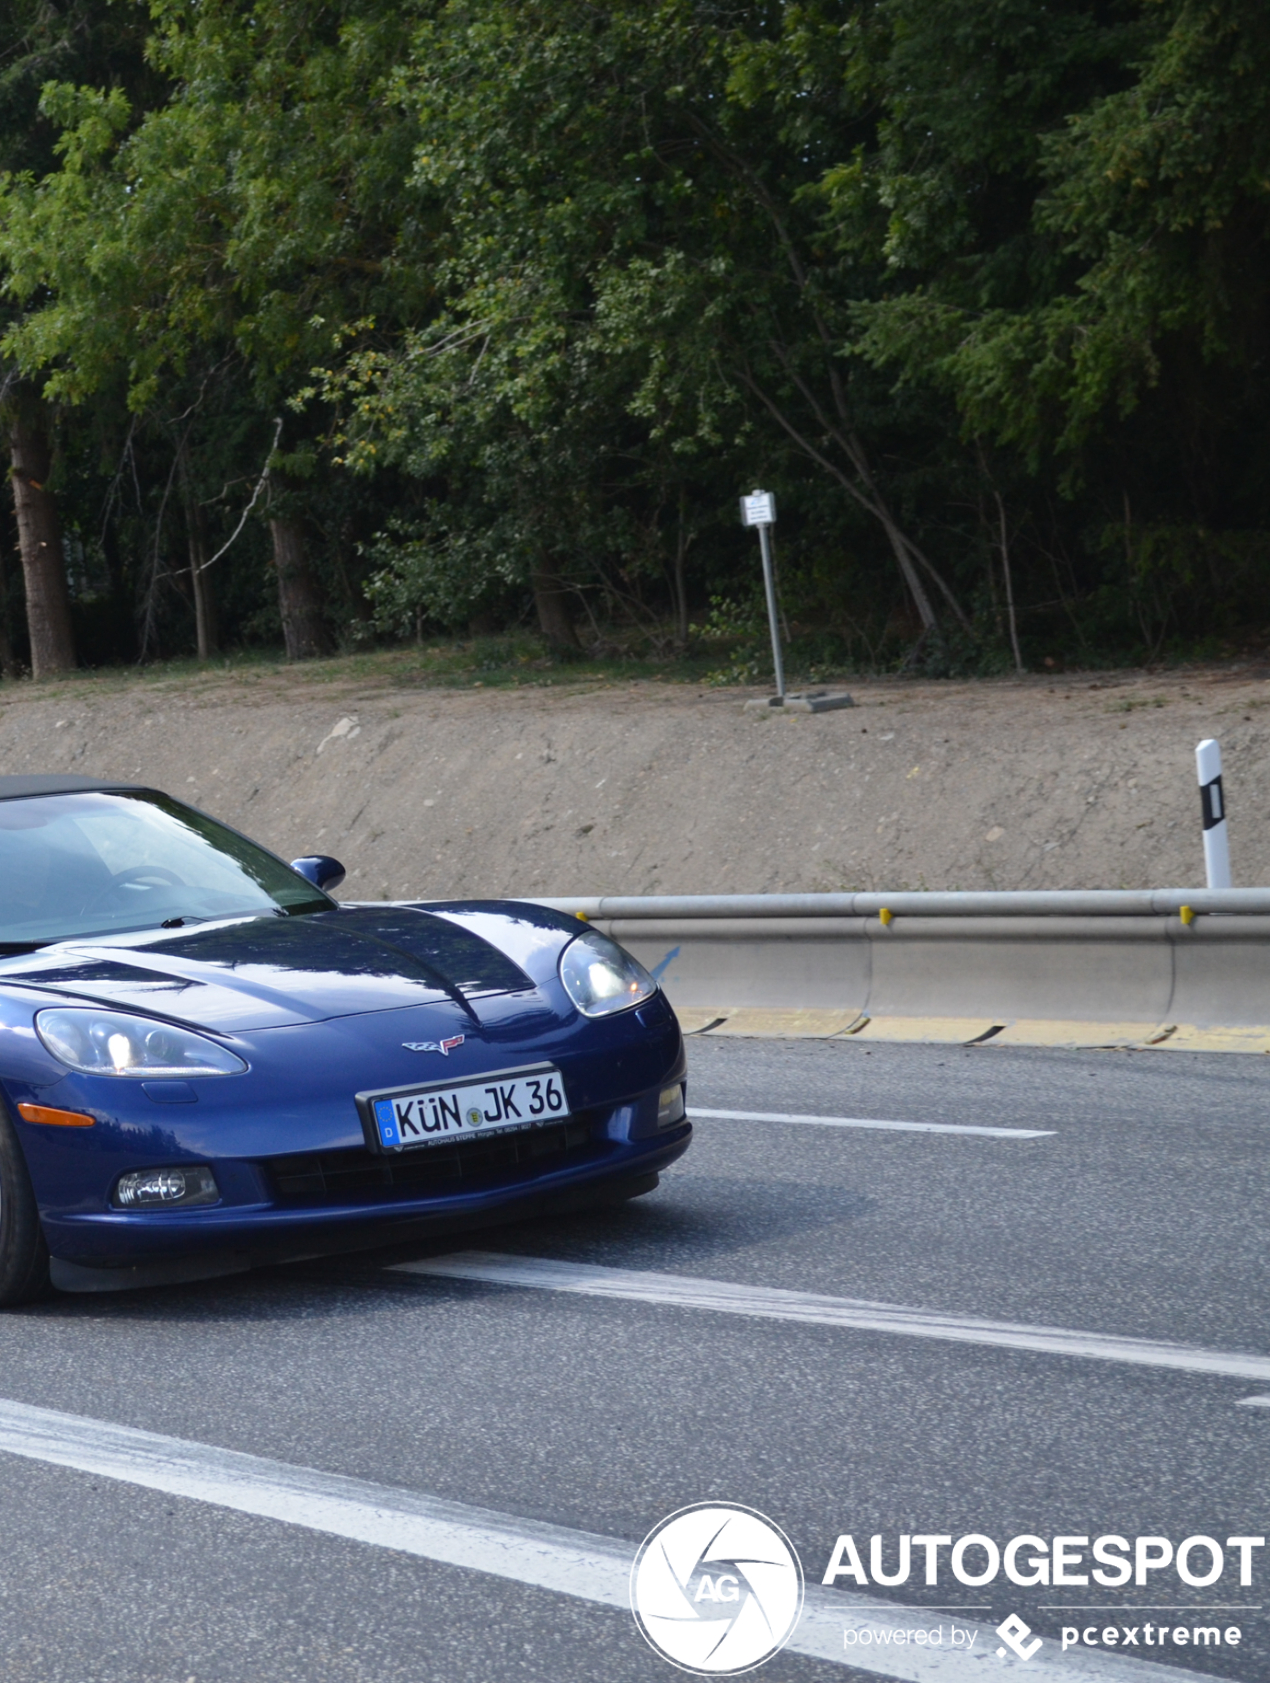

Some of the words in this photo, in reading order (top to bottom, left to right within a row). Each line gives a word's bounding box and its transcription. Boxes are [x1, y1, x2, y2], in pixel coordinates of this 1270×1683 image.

[385, 1127, 393, 1138] D
[396, 1094, 463, 1137] KÜN
[484, 1084, 522, 1122] JK
[526, 1078, 563, 1115] 36
